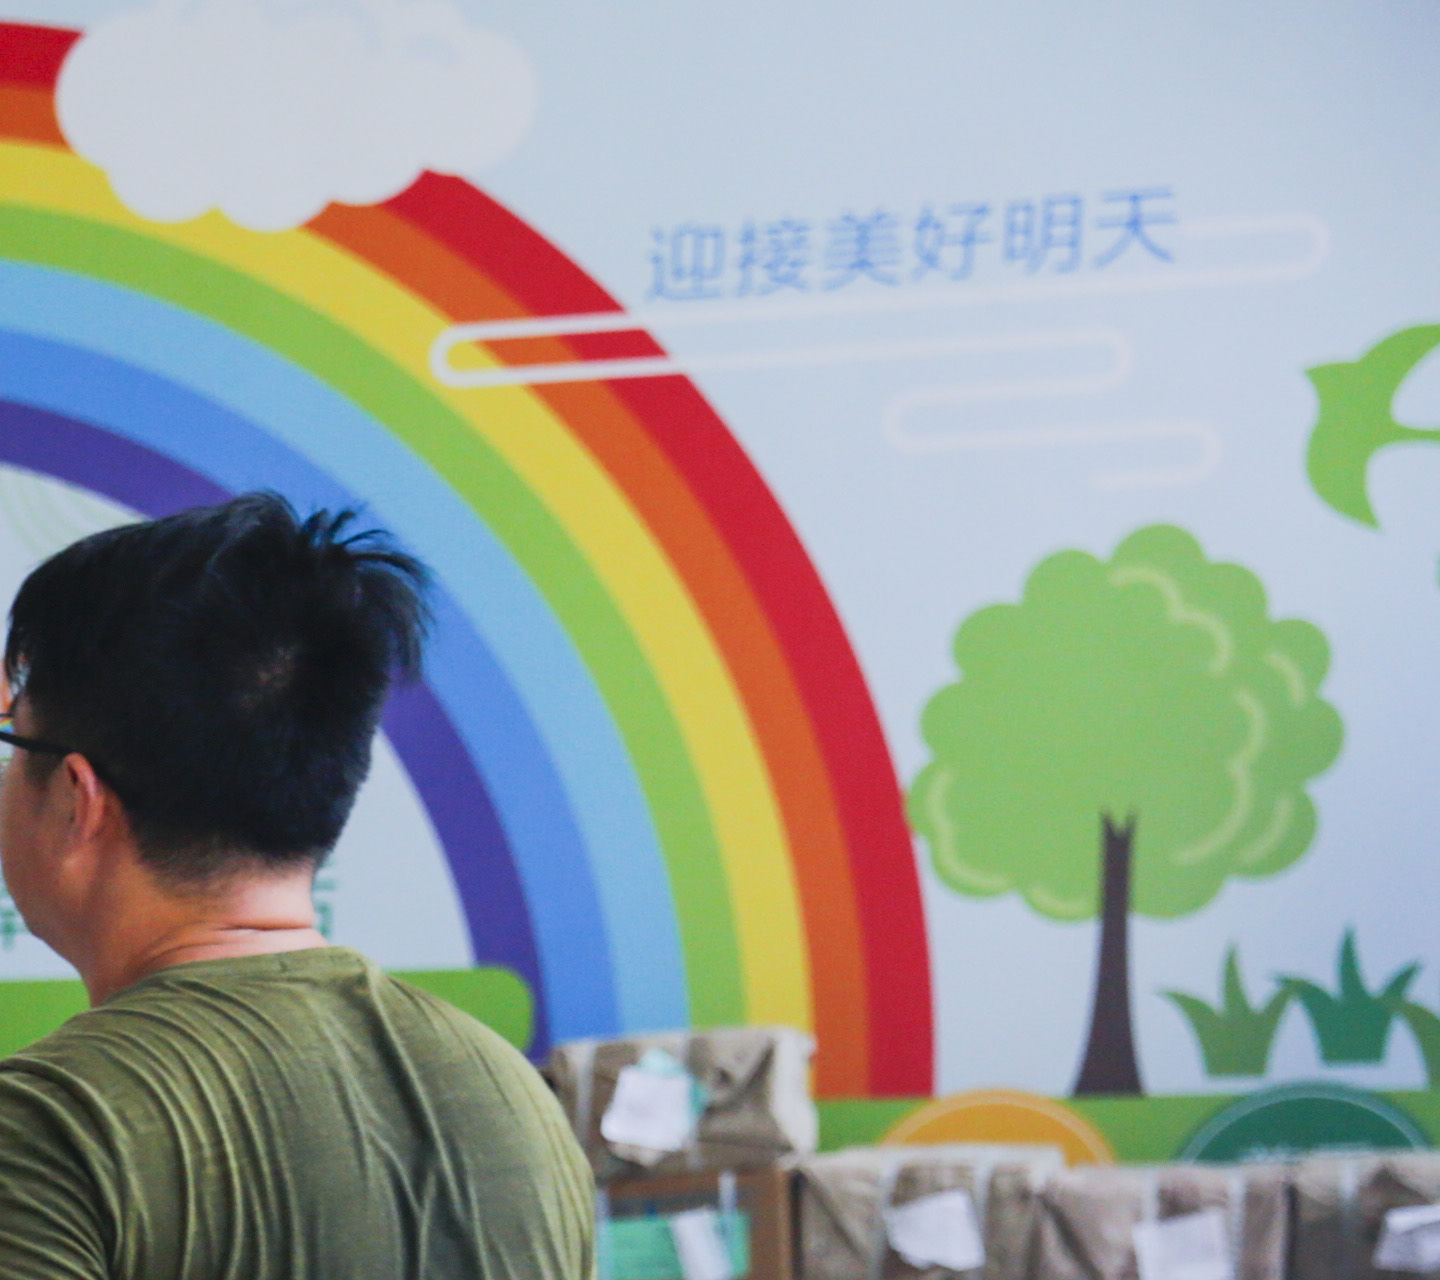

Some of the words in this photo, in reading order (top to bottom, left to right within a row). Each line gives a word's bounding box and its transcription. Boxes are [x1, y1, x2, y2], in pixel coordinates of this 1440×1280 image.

[645, 184, 1178, 303] 迎接美好明天
